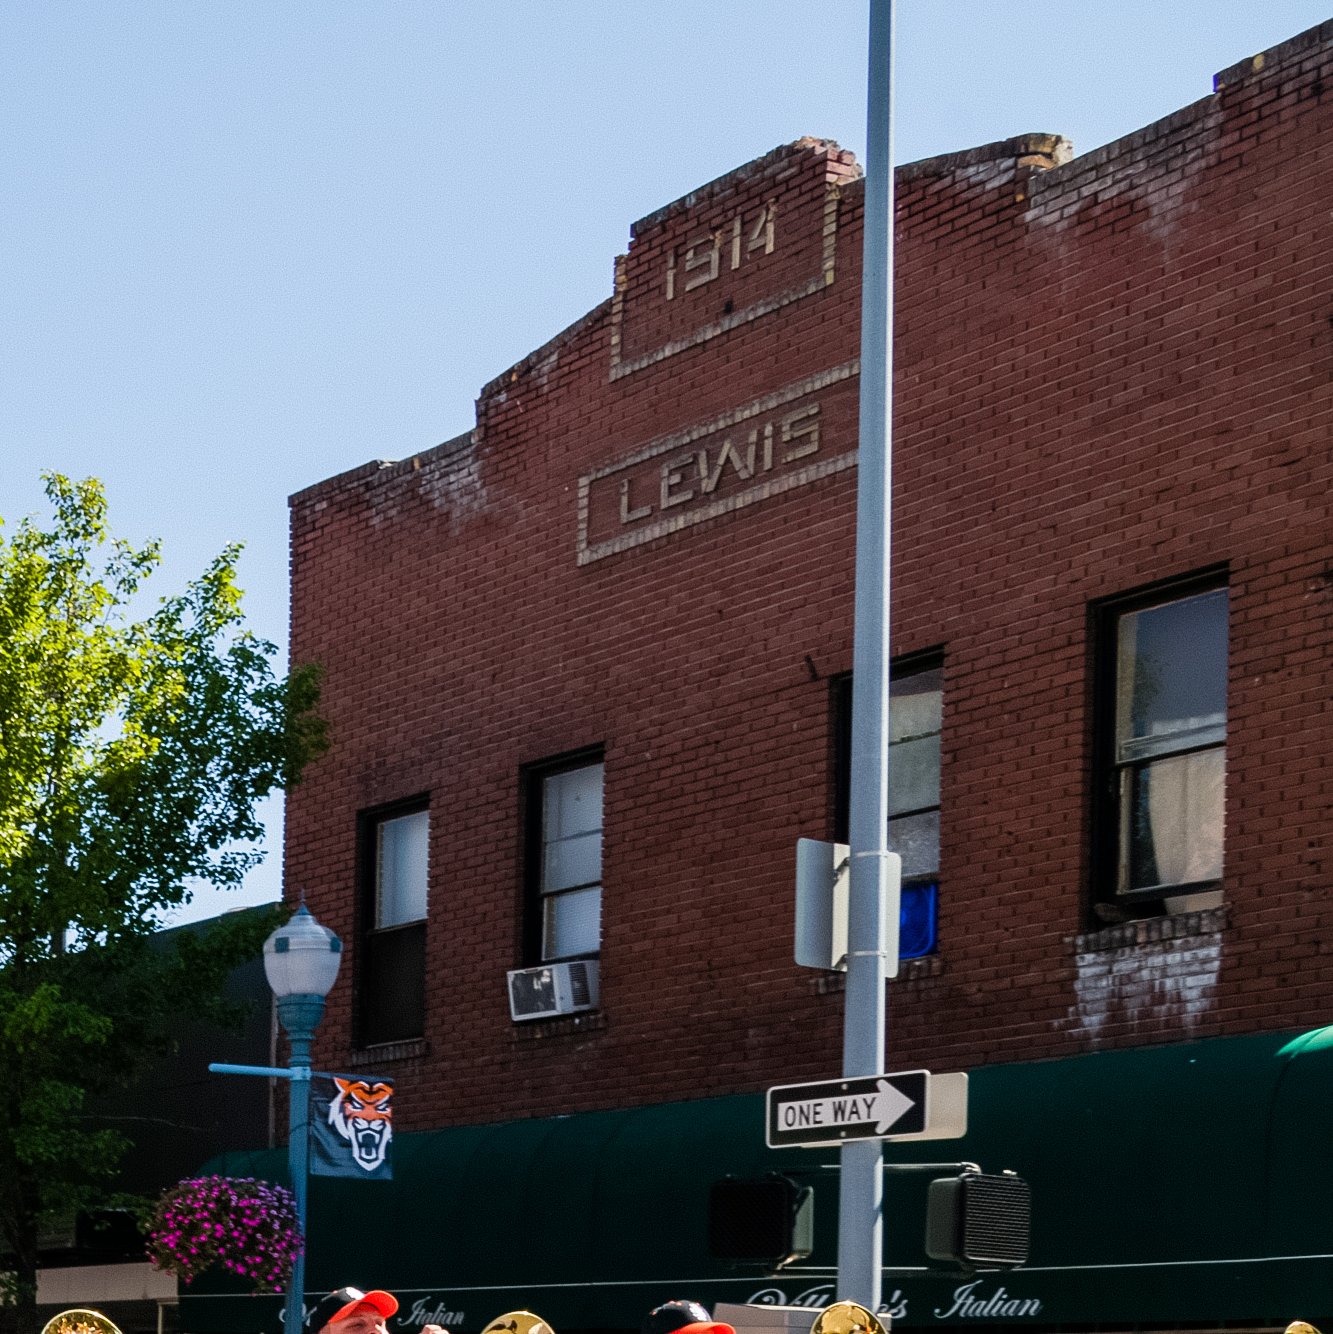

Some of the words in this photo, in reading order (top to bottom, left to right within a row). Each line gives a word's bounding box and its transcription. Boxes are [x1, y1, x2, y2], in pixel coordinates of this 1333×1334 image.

[666, 198, 778, 300] 1914
[620, 403, 820, 525] LEWIS
[784, 1103, 823, 1128] ONE
[833, 1097, 876, 1123] WAY
[397, 1296, 465, 1326] Italian
[934, 1280, 1040, 1318] Italian
